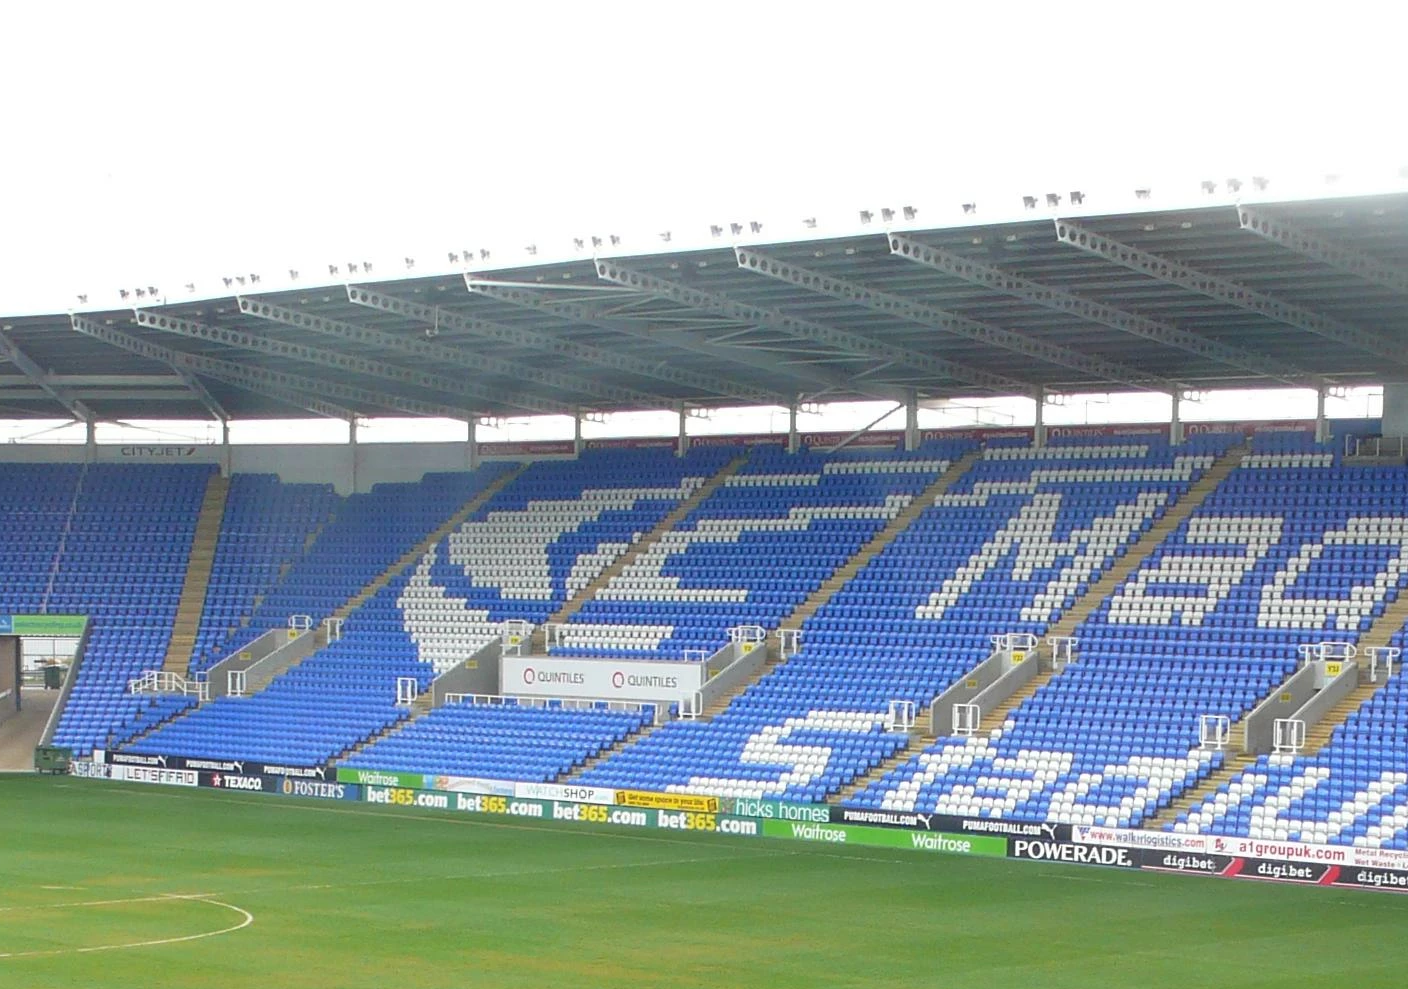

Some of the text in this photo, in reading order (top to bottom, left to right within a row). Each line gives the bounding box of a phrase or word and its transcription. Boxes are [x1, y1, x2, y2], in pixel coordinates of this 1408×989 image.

[120, 447, 182, 457] CITYJET
[537, 671, 585, 684] QUINTILES
[627, 675, 678, 689] QUINTILES
[223, 775, 261, 790] TEXACO
[294, 779, 344, 799] FOSTER'S
[358, 771, 400, 787] Waitrose
[367, 786, 448, 809] bet365.com
[457, 793, 543, 817] bet365.com
[553, 802, 647, 826] bet365.com
[736, 799, 830, 823] hicks homes
[843, 810, 918, 826] PUMAFOOTBALL.COM
[657, 809, 757, 835] bet365.com
[962, 819, 1041, 836] PUMAFOOTBALL.COM
[791, 823, 847, 843] Waitrose
[911, 833, 971, 853] Waitrose
[1014, 839, 1128, 866] POWERADE
[1239, 841, 1345, 861] a1groupuk.com
[1163, 855, 1213, 872] digibet
[1257, 863, 1313, 881] digibet
